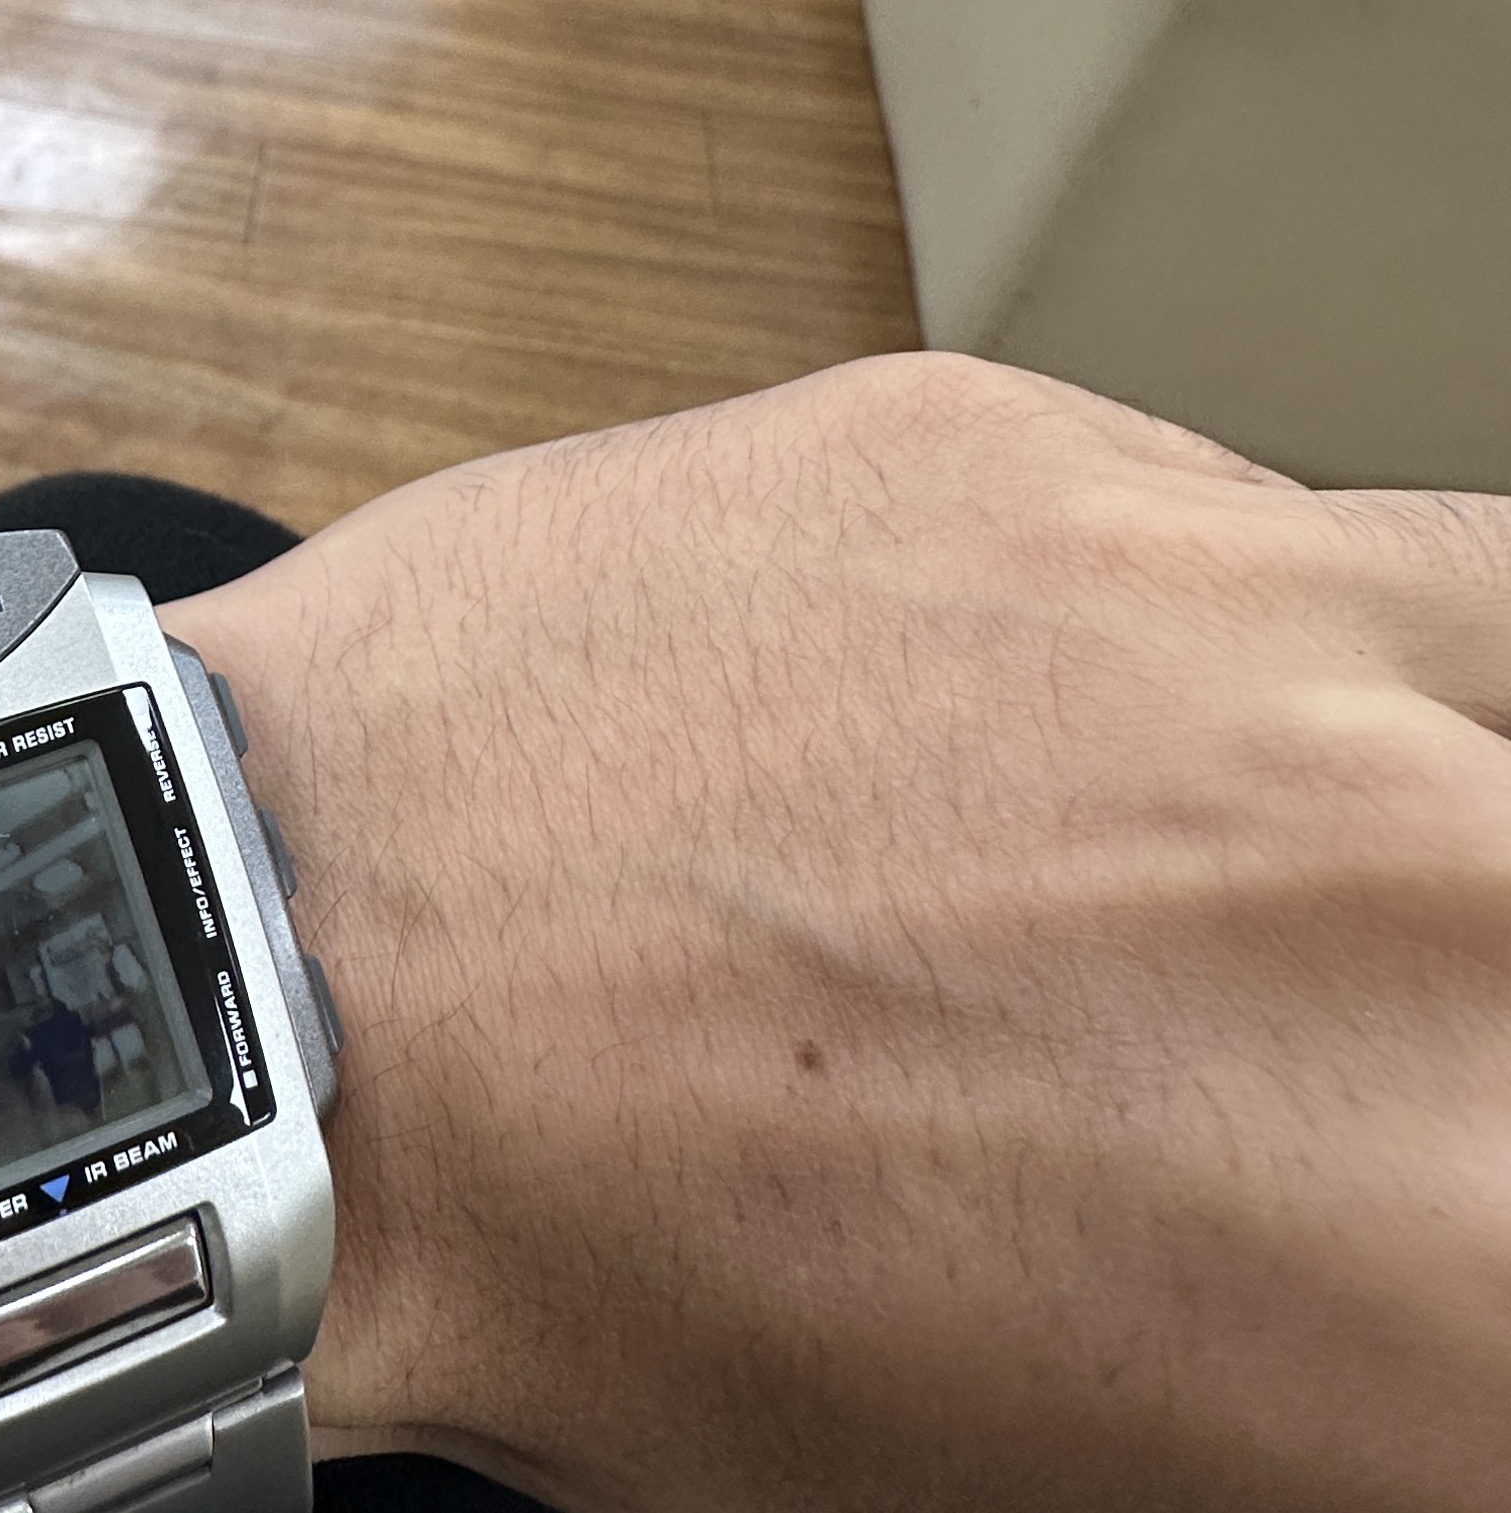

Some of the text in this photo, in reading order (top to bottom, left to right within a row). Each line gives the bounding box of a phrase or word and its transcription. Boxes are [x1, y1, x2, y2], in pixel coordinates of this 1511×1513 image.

[11, 717, 76, 753] RESIST
[173, 826, 218, 939] INFO/EFFECT
[216, 970, 252, 1068] FORWARD
[84, 1131, 178, 1184] IR BEAM
